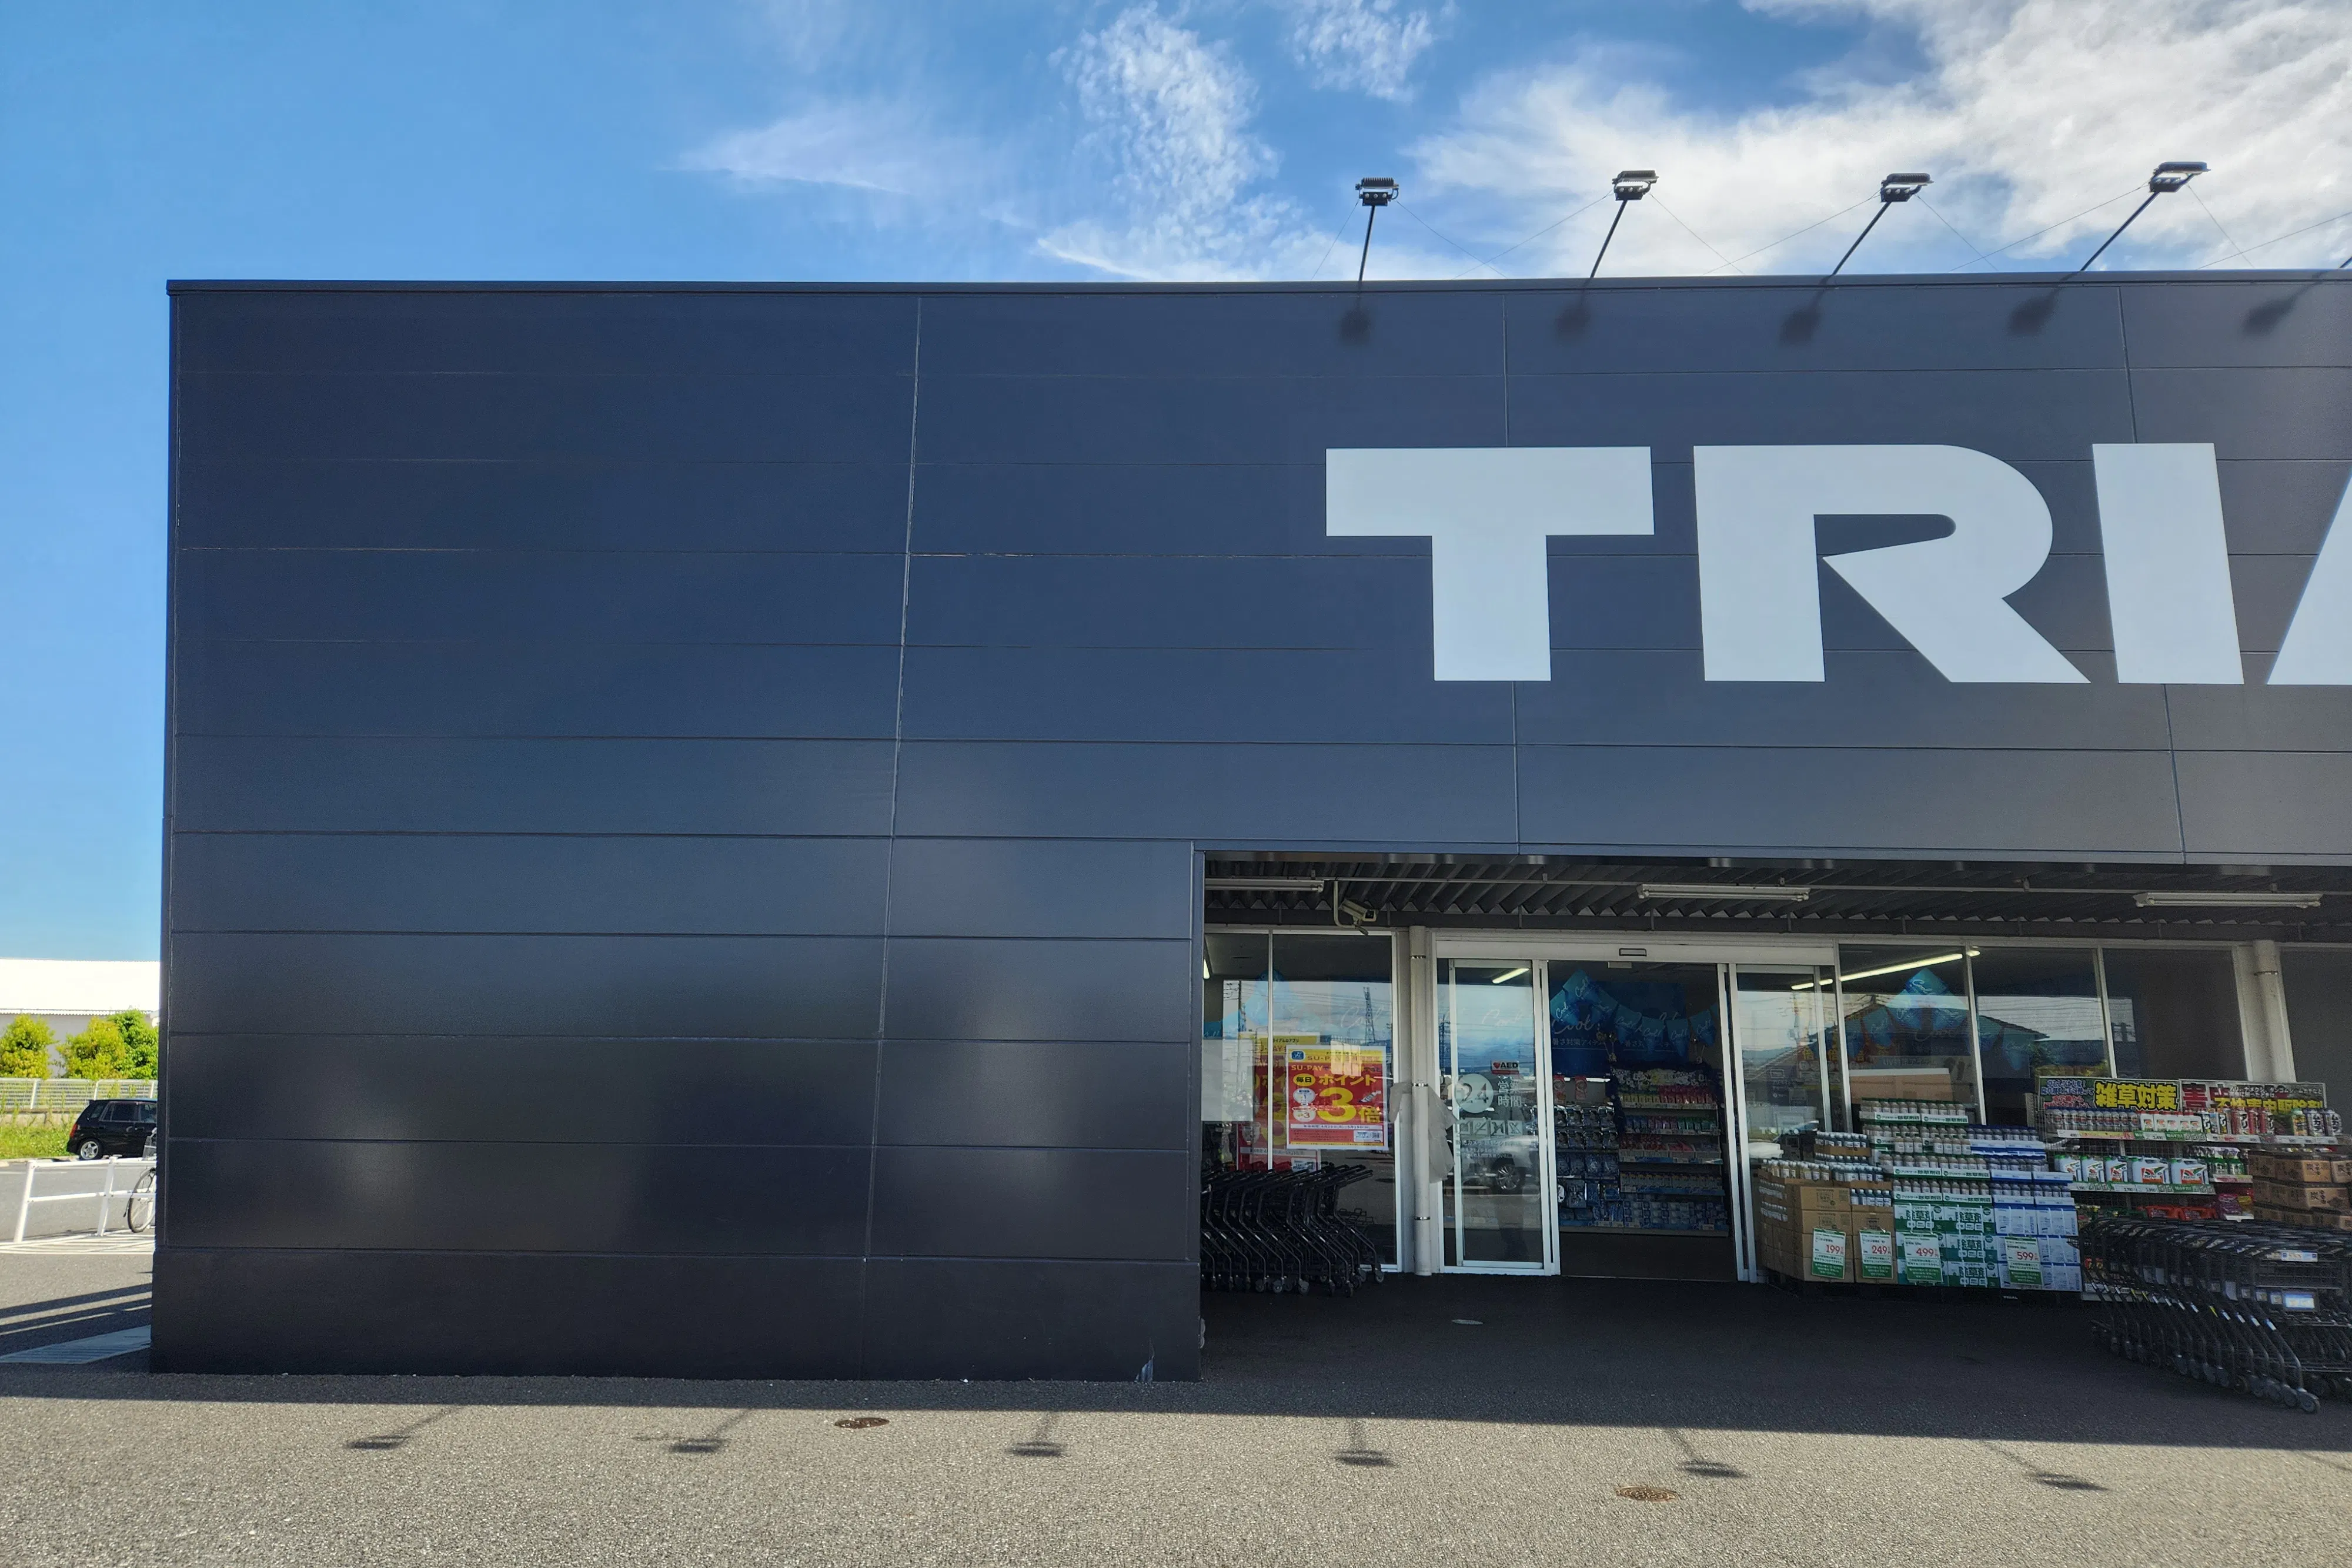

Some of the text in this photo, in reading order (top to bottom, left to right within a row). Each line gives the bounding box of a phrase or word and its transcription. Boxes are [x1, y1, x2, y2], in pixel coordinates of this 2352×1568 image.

[1318, 1074, 1377, 1086] ポイント
[1460, 1083, 1489, 1104] 24
[2095, 1081, 2178, 1110] 雑草対策
[1317, 1086, 1357, 1123] 3
[1498, 1095, 1522, 1108] 時間
[1826, 1244, 1840, 1255] 199
[1872, 1245, 1887, 1255] 249
[1916, 1248, 1934, 1256] 499
[2017, 1251, 2033, 1260] 599
